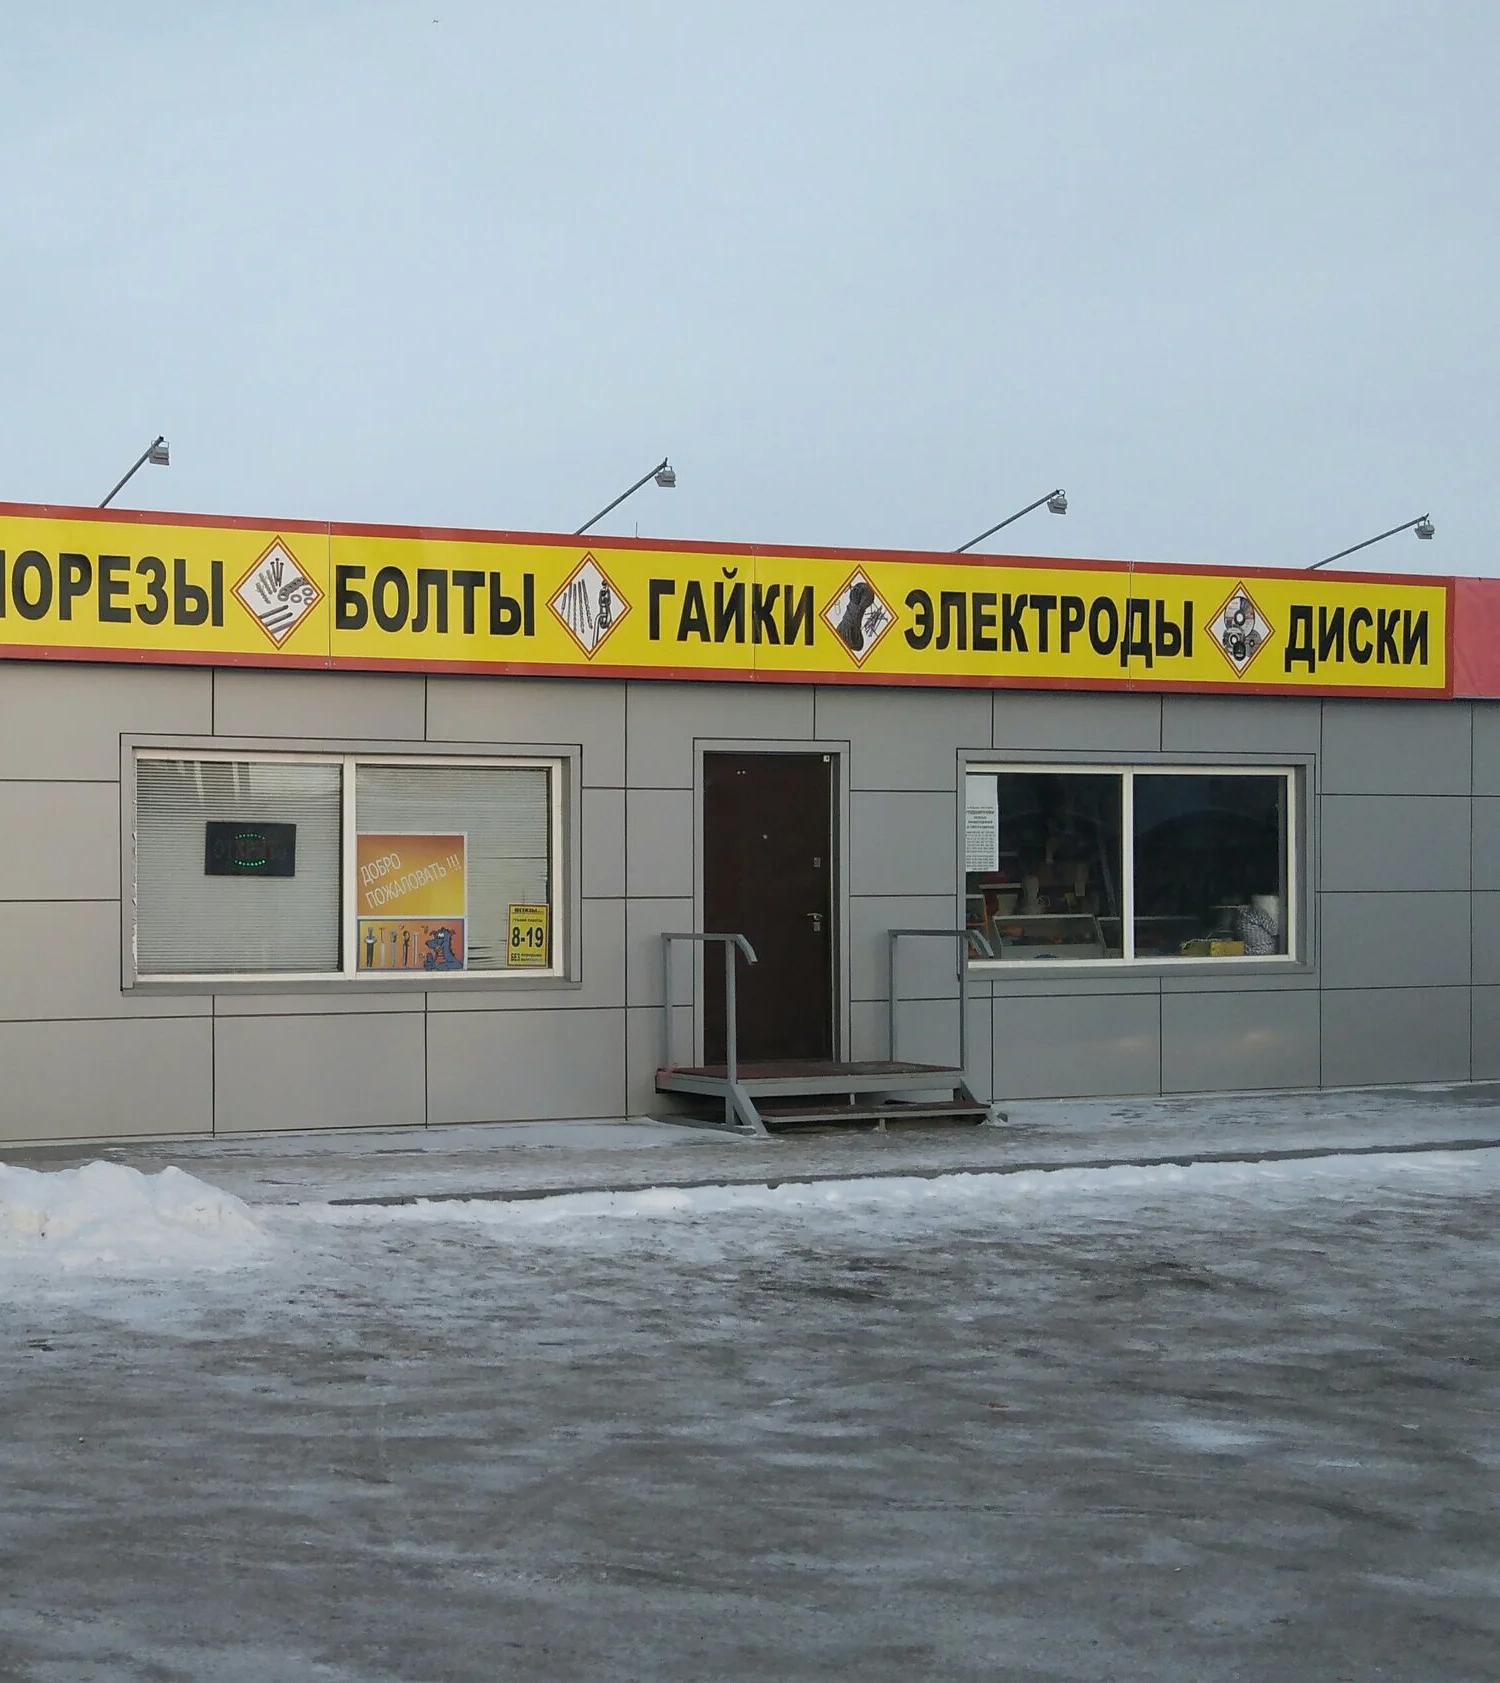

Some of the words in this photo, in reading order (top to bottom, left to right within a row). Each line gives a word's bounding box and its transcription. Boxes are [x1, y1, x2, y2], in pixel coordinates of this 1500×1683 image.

[334, 565, 536, 637] БОЛТЫ
[649, 566, 814, 646] ГАЙКИ
[904, 589, 1194, 669] ЭЛЕКТРОДЫ
[1284, 605, 1429, 674] ДИСКИ
[360, 853, 401, 886] ДОБРО
[365, 862, 447, 909] ПОЖАЛОВАТЬ
[511, 926, 544, 948] 8-19
